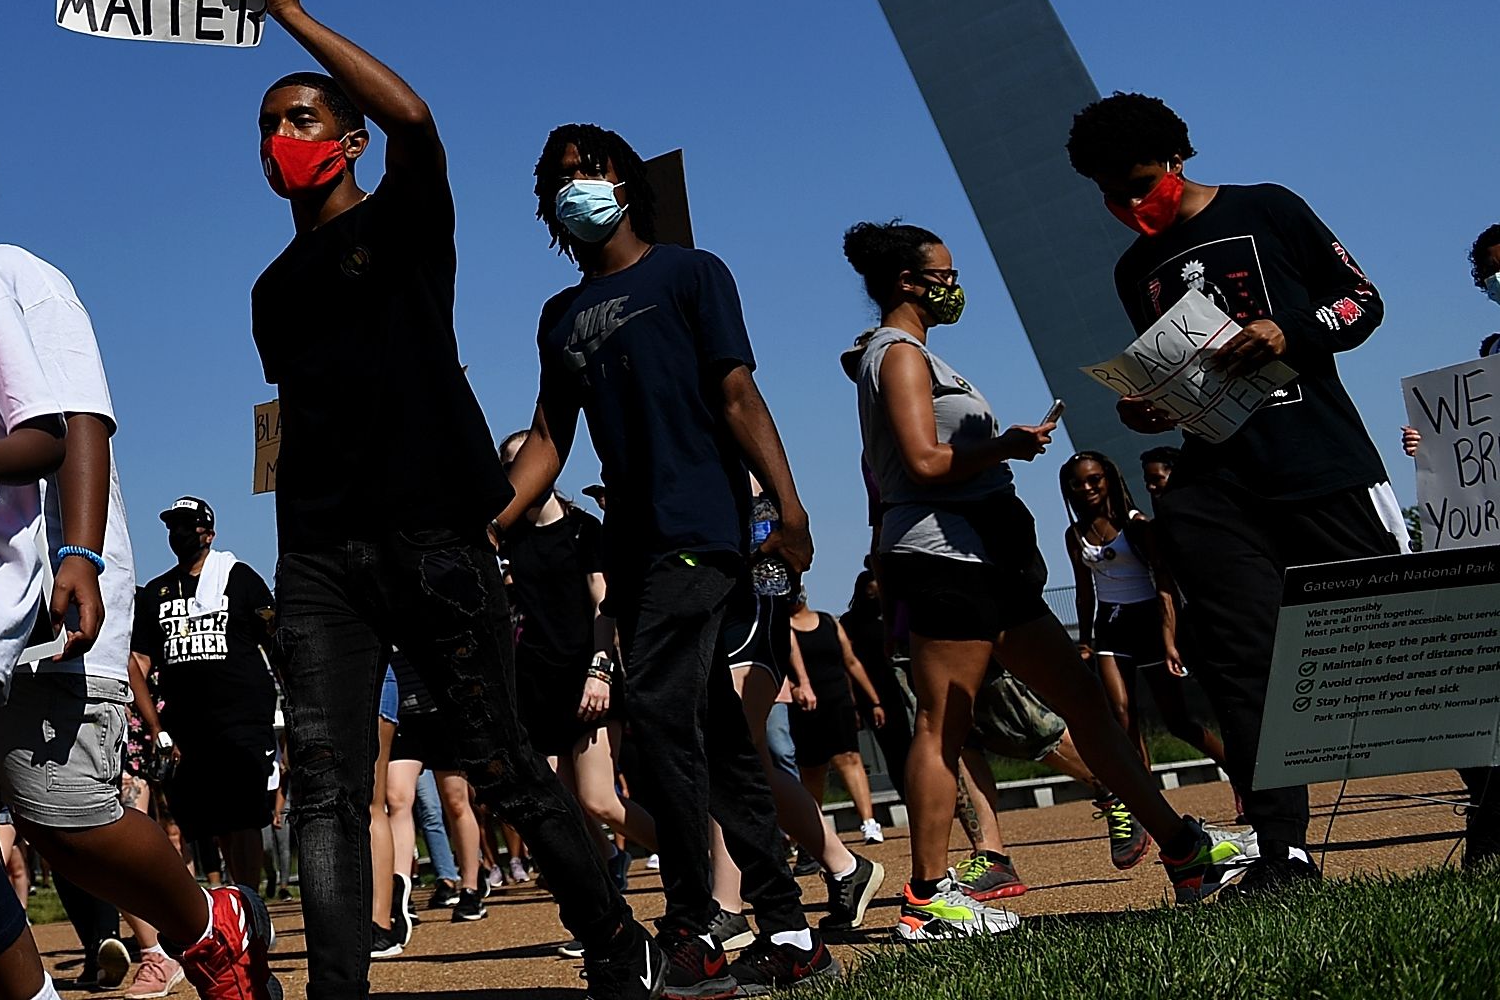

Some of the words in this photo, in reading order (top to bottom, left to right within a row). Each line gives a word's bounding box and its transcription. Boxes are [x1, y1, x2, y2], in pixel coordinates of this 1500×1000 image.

[570, 294, 630, 342] NIKE
[1092, 315, 1207, 396] BLACK
[1154, 356, 1230, 419] IVES
[1187, 371, 1277, 440] ATTER
[1411, 368, 1493, 434] WE
[1453, 431, 1500, 489] BR
[1425, 497, 1500, 550] YOUR
[1303, 576, 1364, 593] Gateway
[1367, 571, 1399, 585] Arch
[1403, 564, 1462, 581] National
[1466, 561, 1496, 575] Park
[159, 594, 229, 618] PROD
[1305, 619, 1322, 628] We
[1323, 618, 1339, 626] are
[1340, 616, 1352, 624] all
[1353, 615, 1363, 623] in
[1365, 612, 1382, 621] this
[1383, 607, 1425, 620] together.
[1308, 608, 1328, 618] Visit
[1329, 602, 1383, 616] responsibly
[161, 614, 228, 638] BLACK
[1304, 628, 1328, 638] Most
[1329, 625, 1350, 637] park
[1352, 620, 1390, 633] grounds
[1391, 619, 1407, 628] are
[1408, 615, 1455, 626] accessible,
[1457, 612, 1474, 622] but
[164, 634, 229, 659] FATHER
[1301, 647, 1338, 658] Please
[1339, 642, 1366, 655] help
[1368, 638, 1396, 652] keep
[1399, 636, 1419, 647] the
[1420, 633, 1447, 647] park
[1449, 628, 1498, 643] grounds
[1322, 658, 1373, 672] Maintain
[1375, 656, 1383, 665] 6
[1386, 652, 1409, 664] feet
[1411, 650, 1426, 661] of
[1427, 647, 1474, 660] distance
[1318, 677, 1353, 690] Avoid
[1354, 671, 1405, 686] crowded
[1406, 669, 1437, 680] areas
[1439, 665, 1455, 677] of
[1455, 663, 1475, 674] the
[1316, 696, 1341, 708] Stay
[1343, 692, 1376, 703] home
[1378, 689, 1388, 700] if
[1389, 689, 1412, 701] you
[1413, 684, 1436, 695] feel
[1438, 682, 1460, 693] sick
[1313, 713, 1333, 722] Park
[1335, 709, 1369, 720] rangers
[1371, 706, 1402, 717] remain
[1419, 701, 1442, 712] duty.
[1444, 698, 1478, 708] Normal
[1322, 746, 1336, 754] you
[1350, 742, 1366, 751] help
[1367, 738, 1394, 749] support
[1395, 736, 1426, 746] Gateway
[1427, 734, 1444, 742] Arch
[1445, 731, 1476, 740] National
[1284, 750, 1371, 767] www.ArchPark.org
